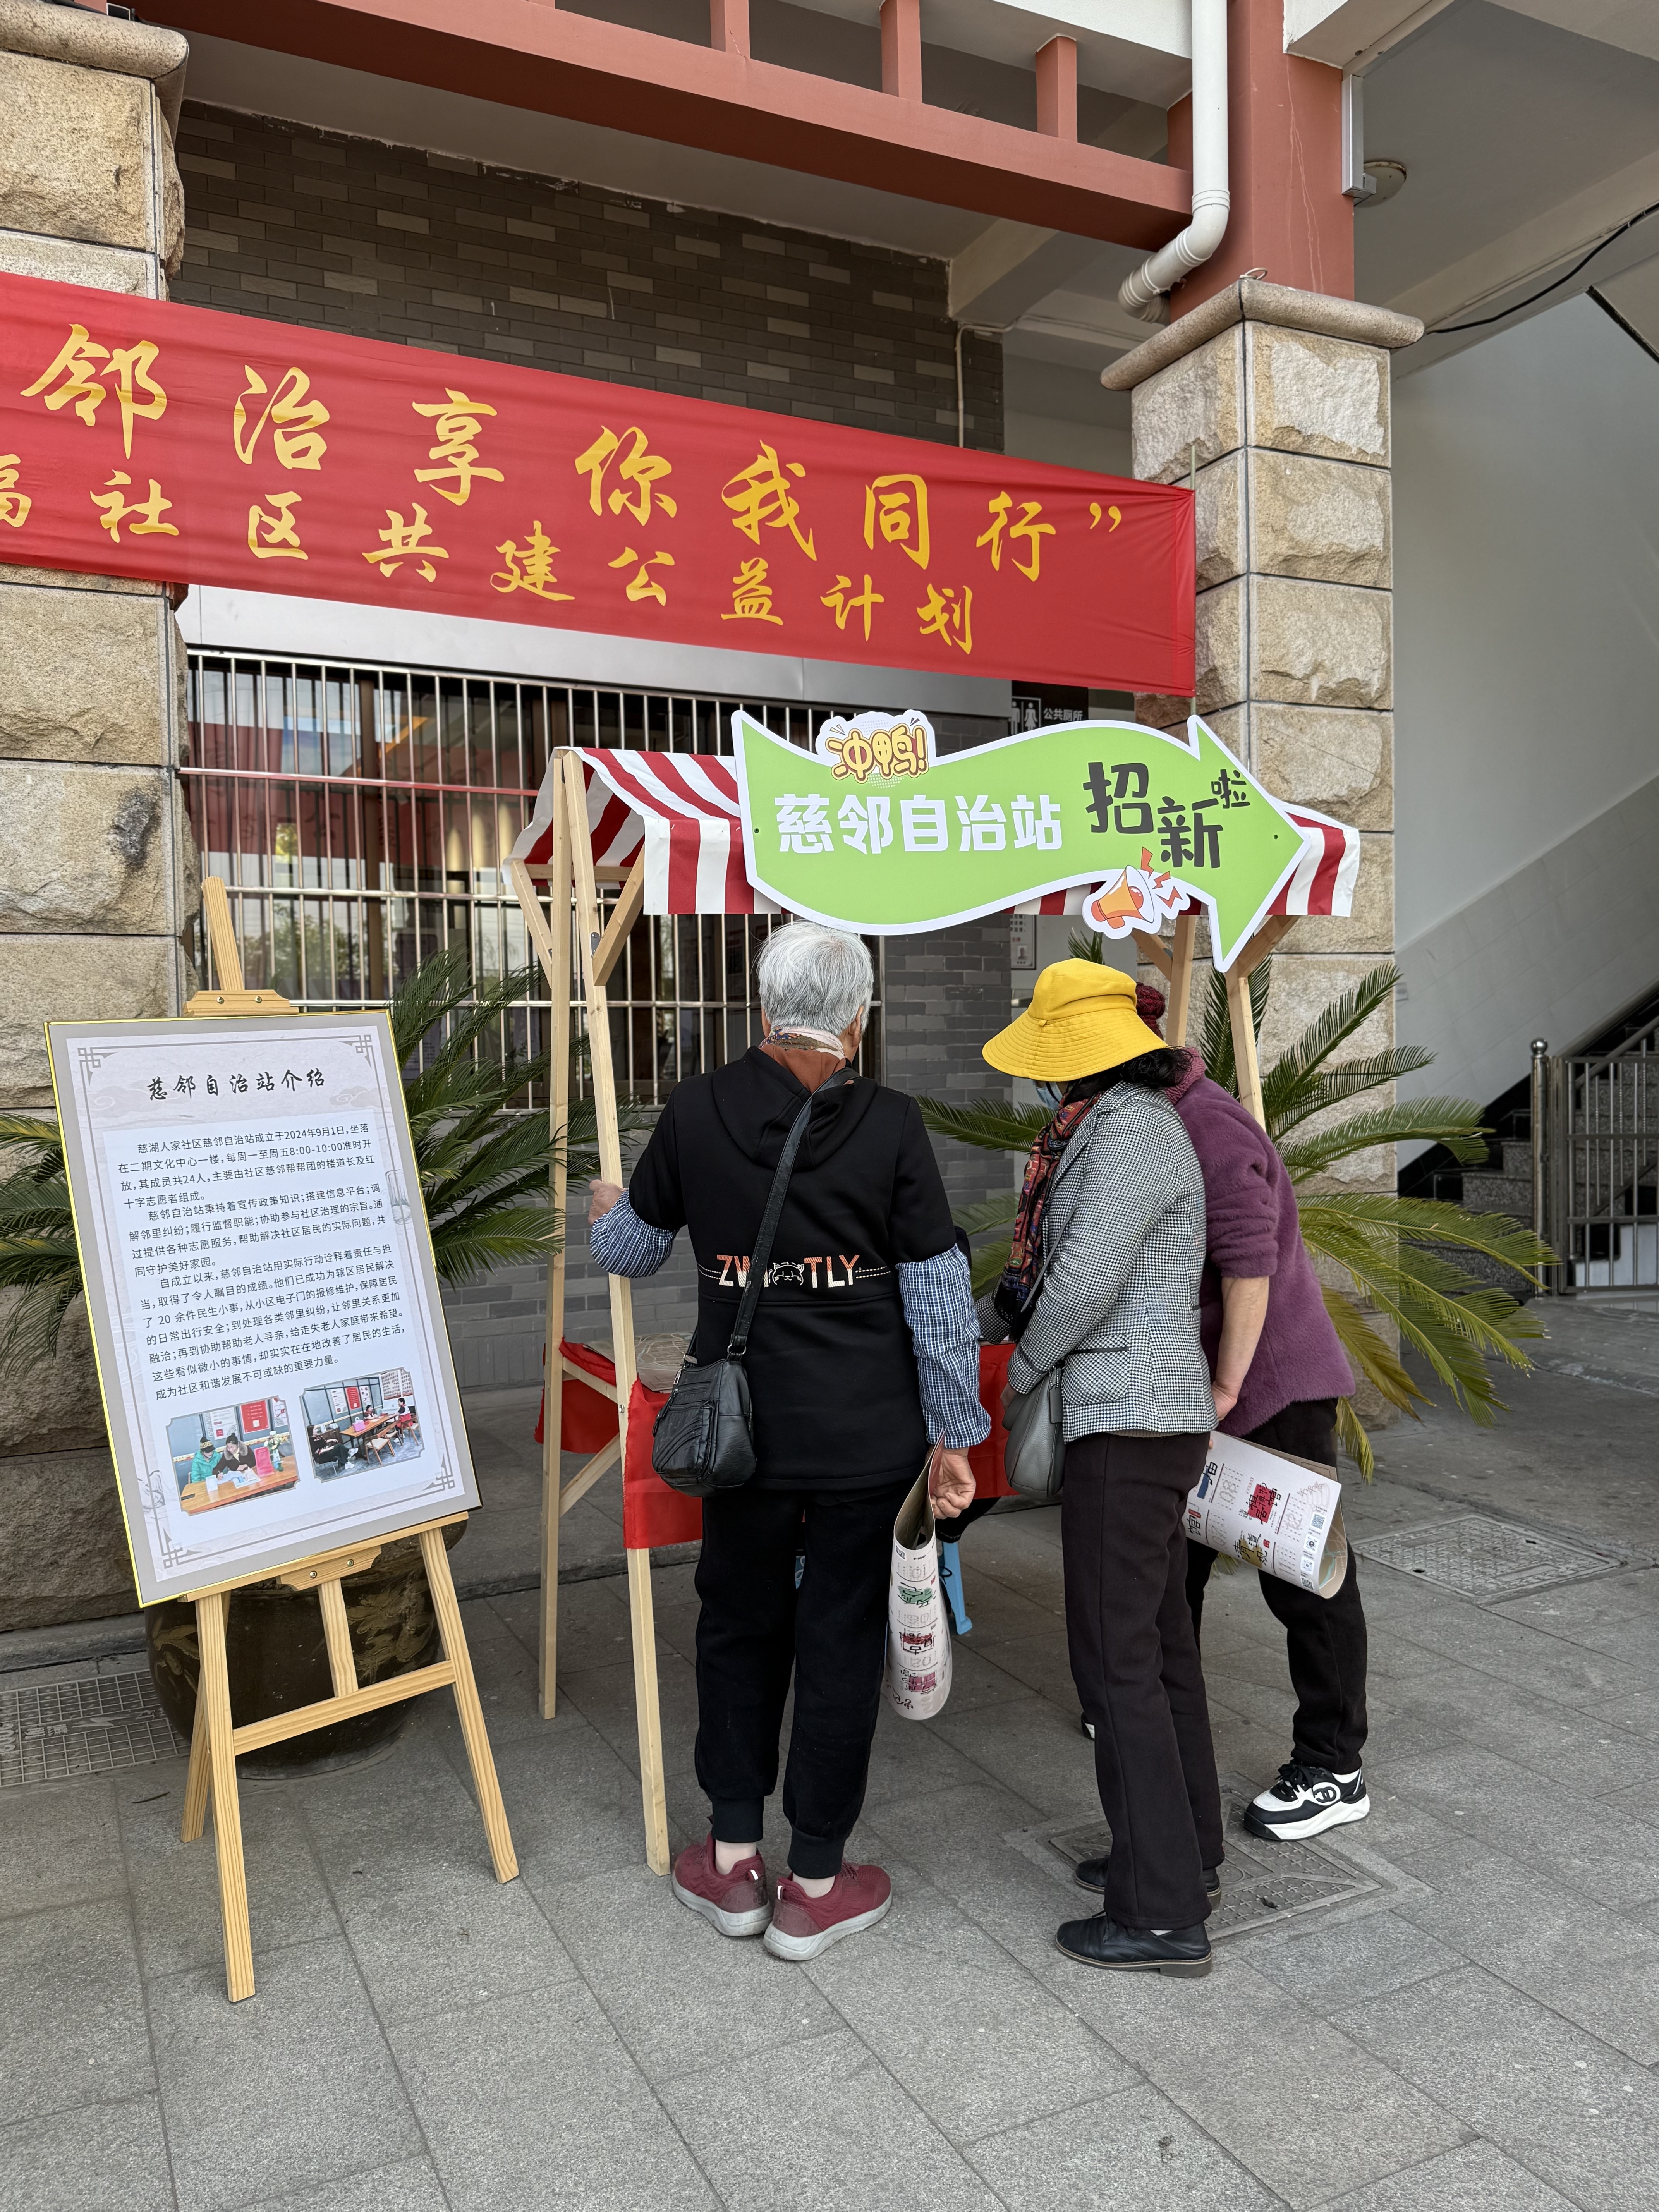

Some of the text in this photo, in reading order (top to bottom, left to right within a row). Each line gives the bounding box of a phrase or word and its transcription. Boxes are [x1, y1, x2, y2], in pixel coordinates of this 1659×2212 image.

[1044, 708, 1083, 721] 公共厕所
[775, 794, 1062, 855] 慈邻自治站
[147, 1068, 325, 1101] 慈邻自治站介绍
[124, 1191, 204, 1209] 十字志愿者组成。
[135, 1257, 216, 1277] 同守护美好家园。
